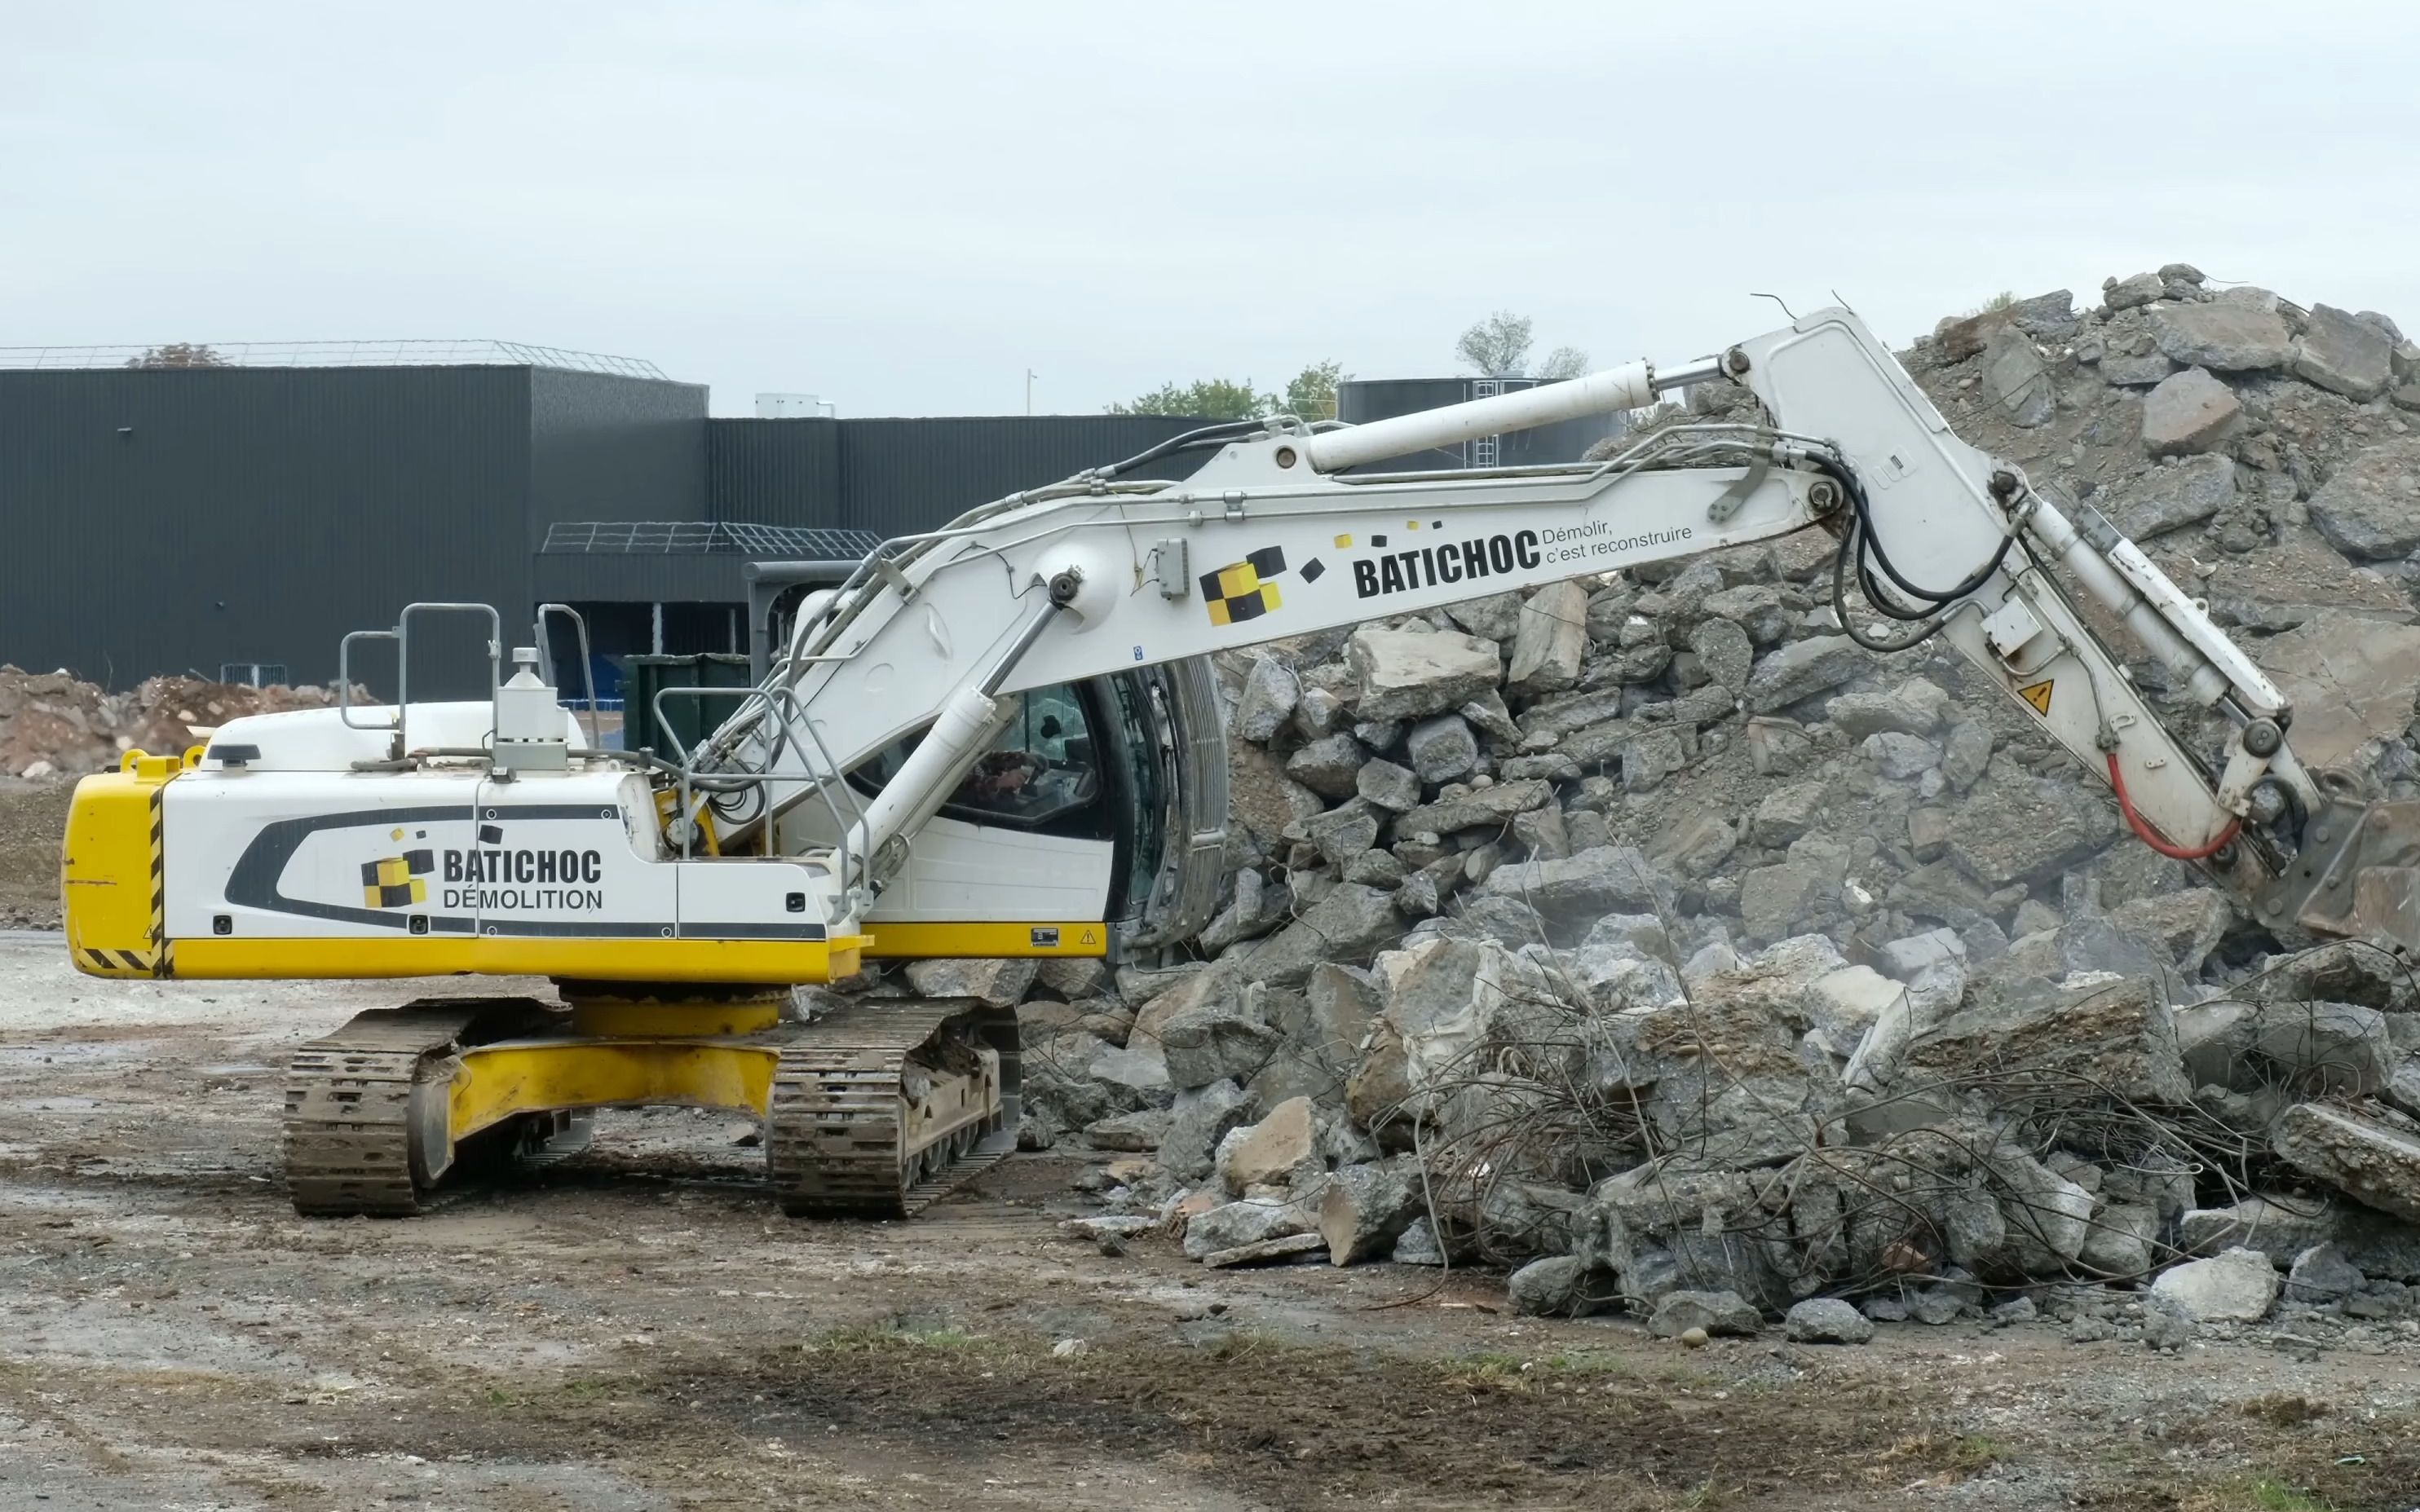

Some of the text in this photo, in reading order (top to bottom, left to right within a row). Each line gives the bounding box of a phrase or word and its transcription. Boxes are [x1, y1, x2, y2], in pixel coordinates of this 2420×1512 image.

[1542, 520, 1613, 544] Démolir,
[1546, 527, 1693, 564] c'est reconstruire
[1353, 530, 1541, 598] BATICHOC
[444, 849, 602, 884] BATICHOC
[444, 884, 603, 910] DÉMOLITION
